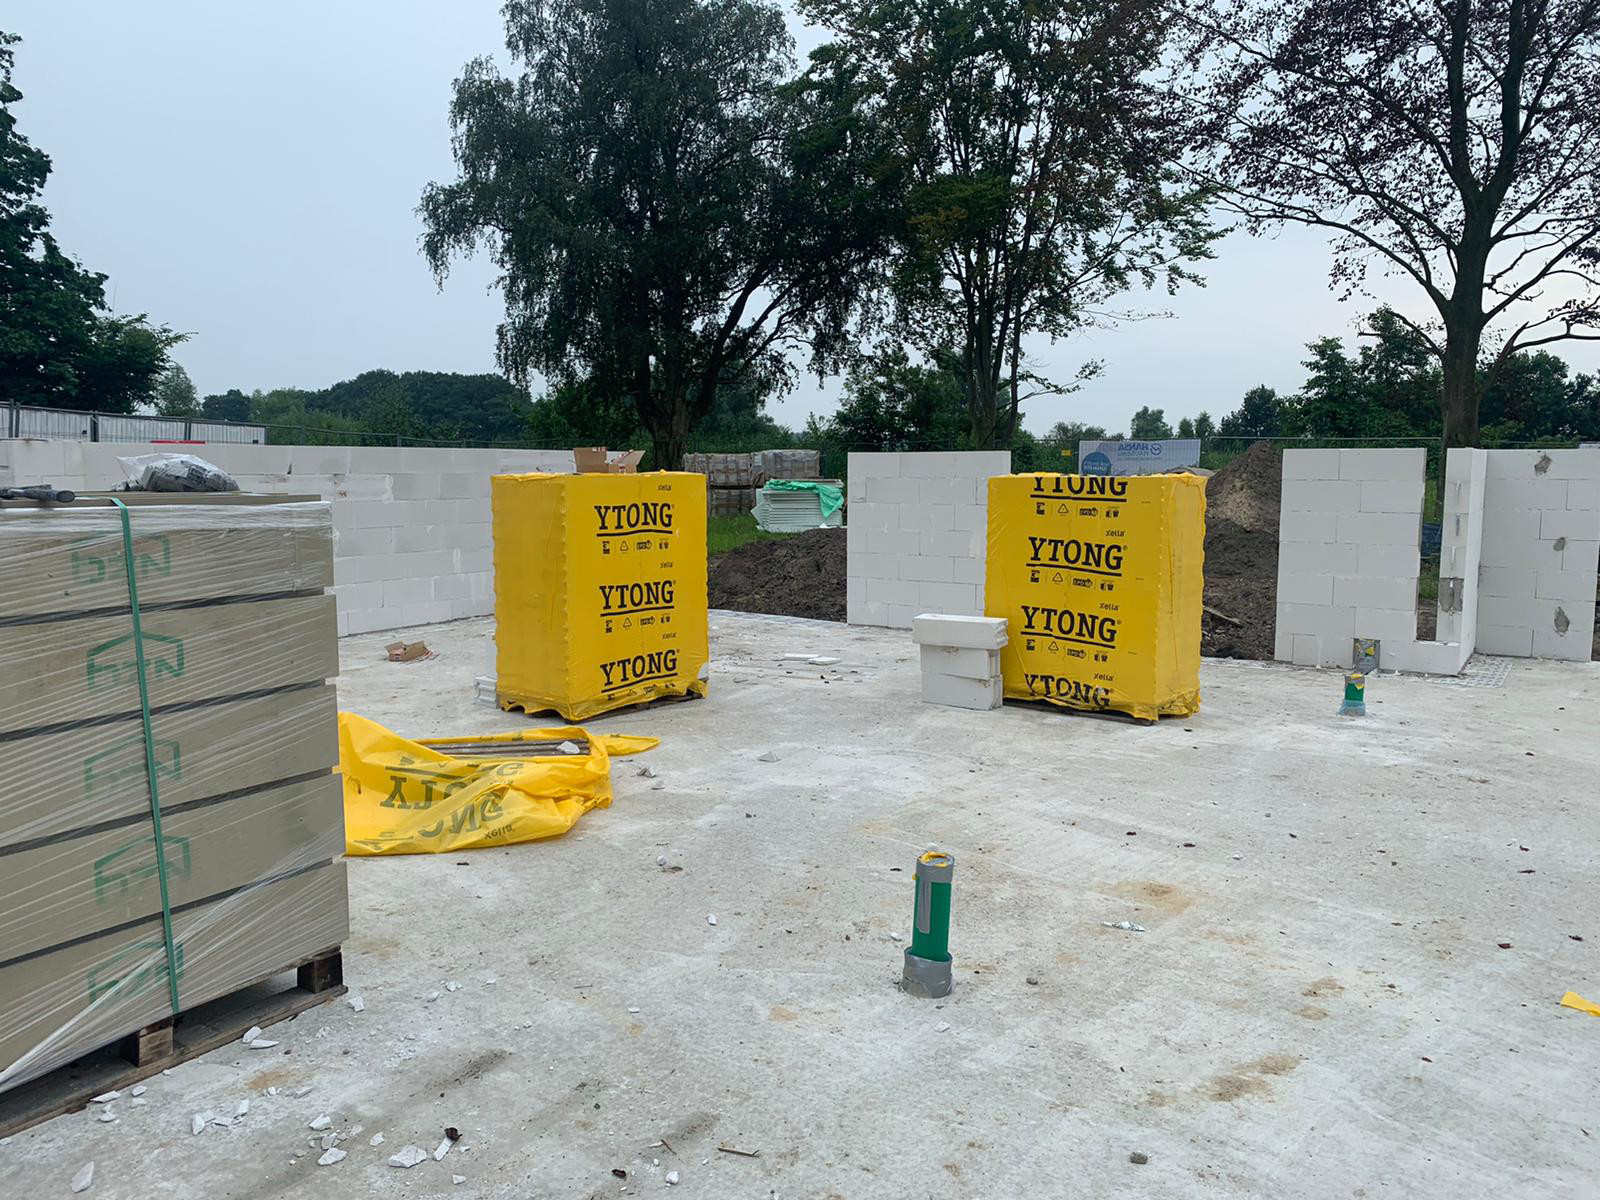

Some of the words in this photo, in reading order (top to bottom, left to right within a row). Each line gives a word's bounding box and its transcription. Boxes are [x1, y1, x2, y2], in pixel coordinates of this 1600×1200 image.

[594, 502, 673, 530] YTONG
[1028, 536, 1123, 570] YTONG
[598, 580, 674, 610] YTONG
[1021, 605, 1117, 643] YTONG
[600, 649, 677, 686] YTONG
[1024, 672, 1111, 708] YTONG
